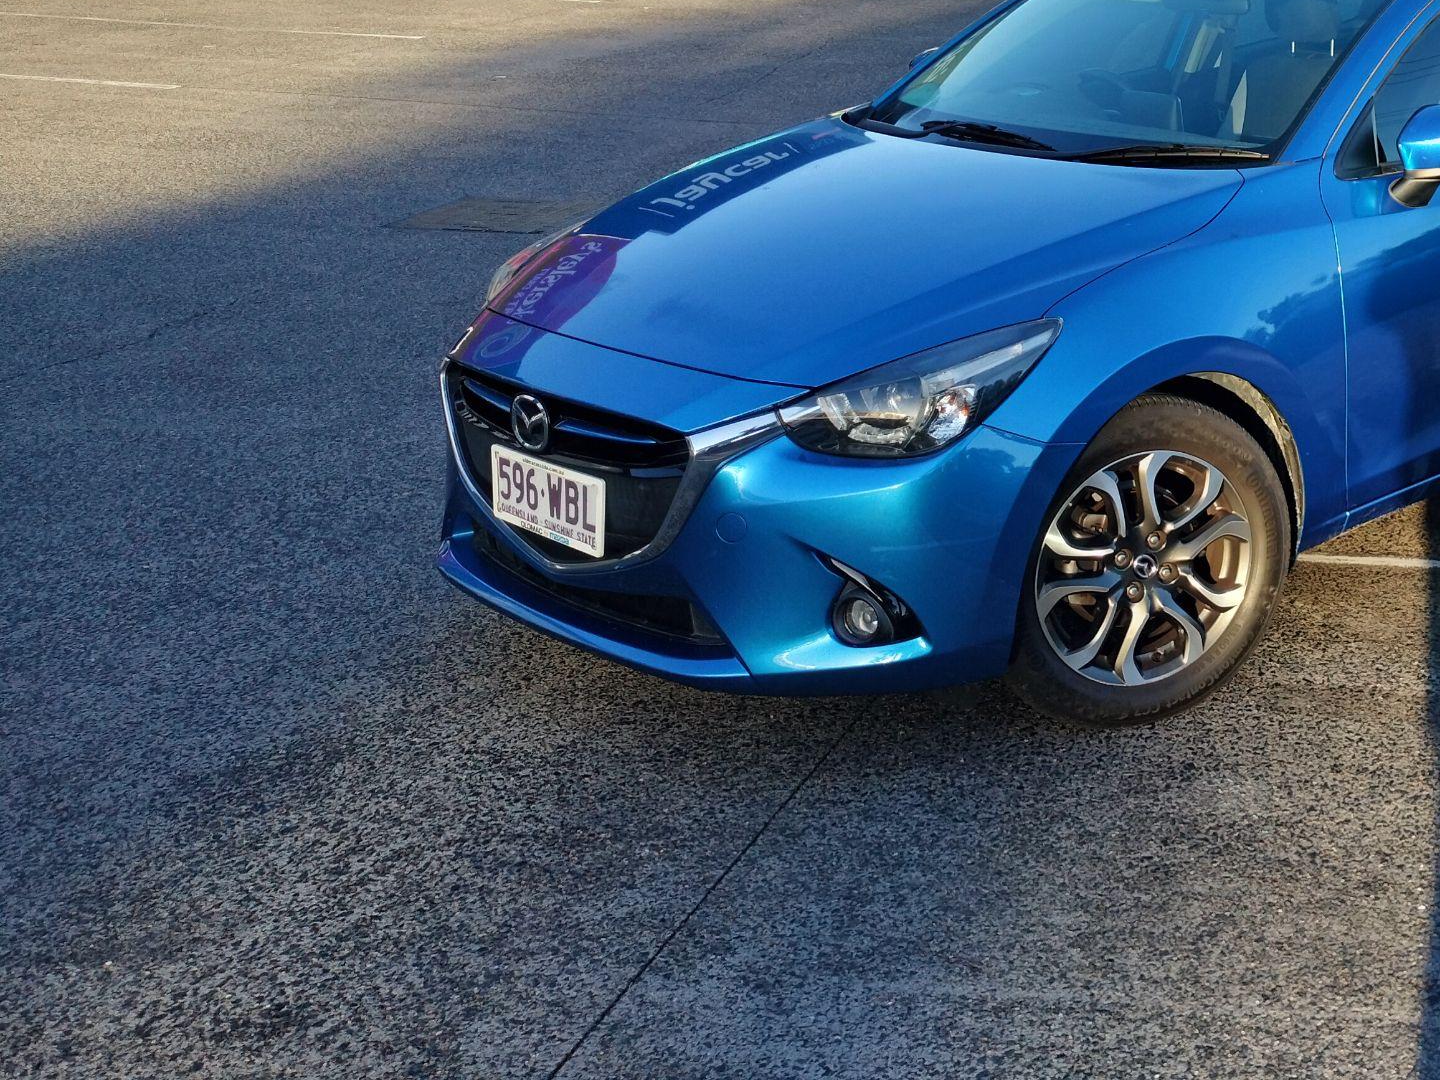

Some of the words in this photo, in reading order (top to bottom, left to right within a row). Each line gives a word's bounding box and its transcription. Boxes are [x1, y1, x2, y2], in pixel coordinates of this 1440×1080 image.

[501, 501, 539, 525] QUEENSLAND
[544, 519, 574, 540] SUNSHINE
[576, 531, 597, 548] STATE
